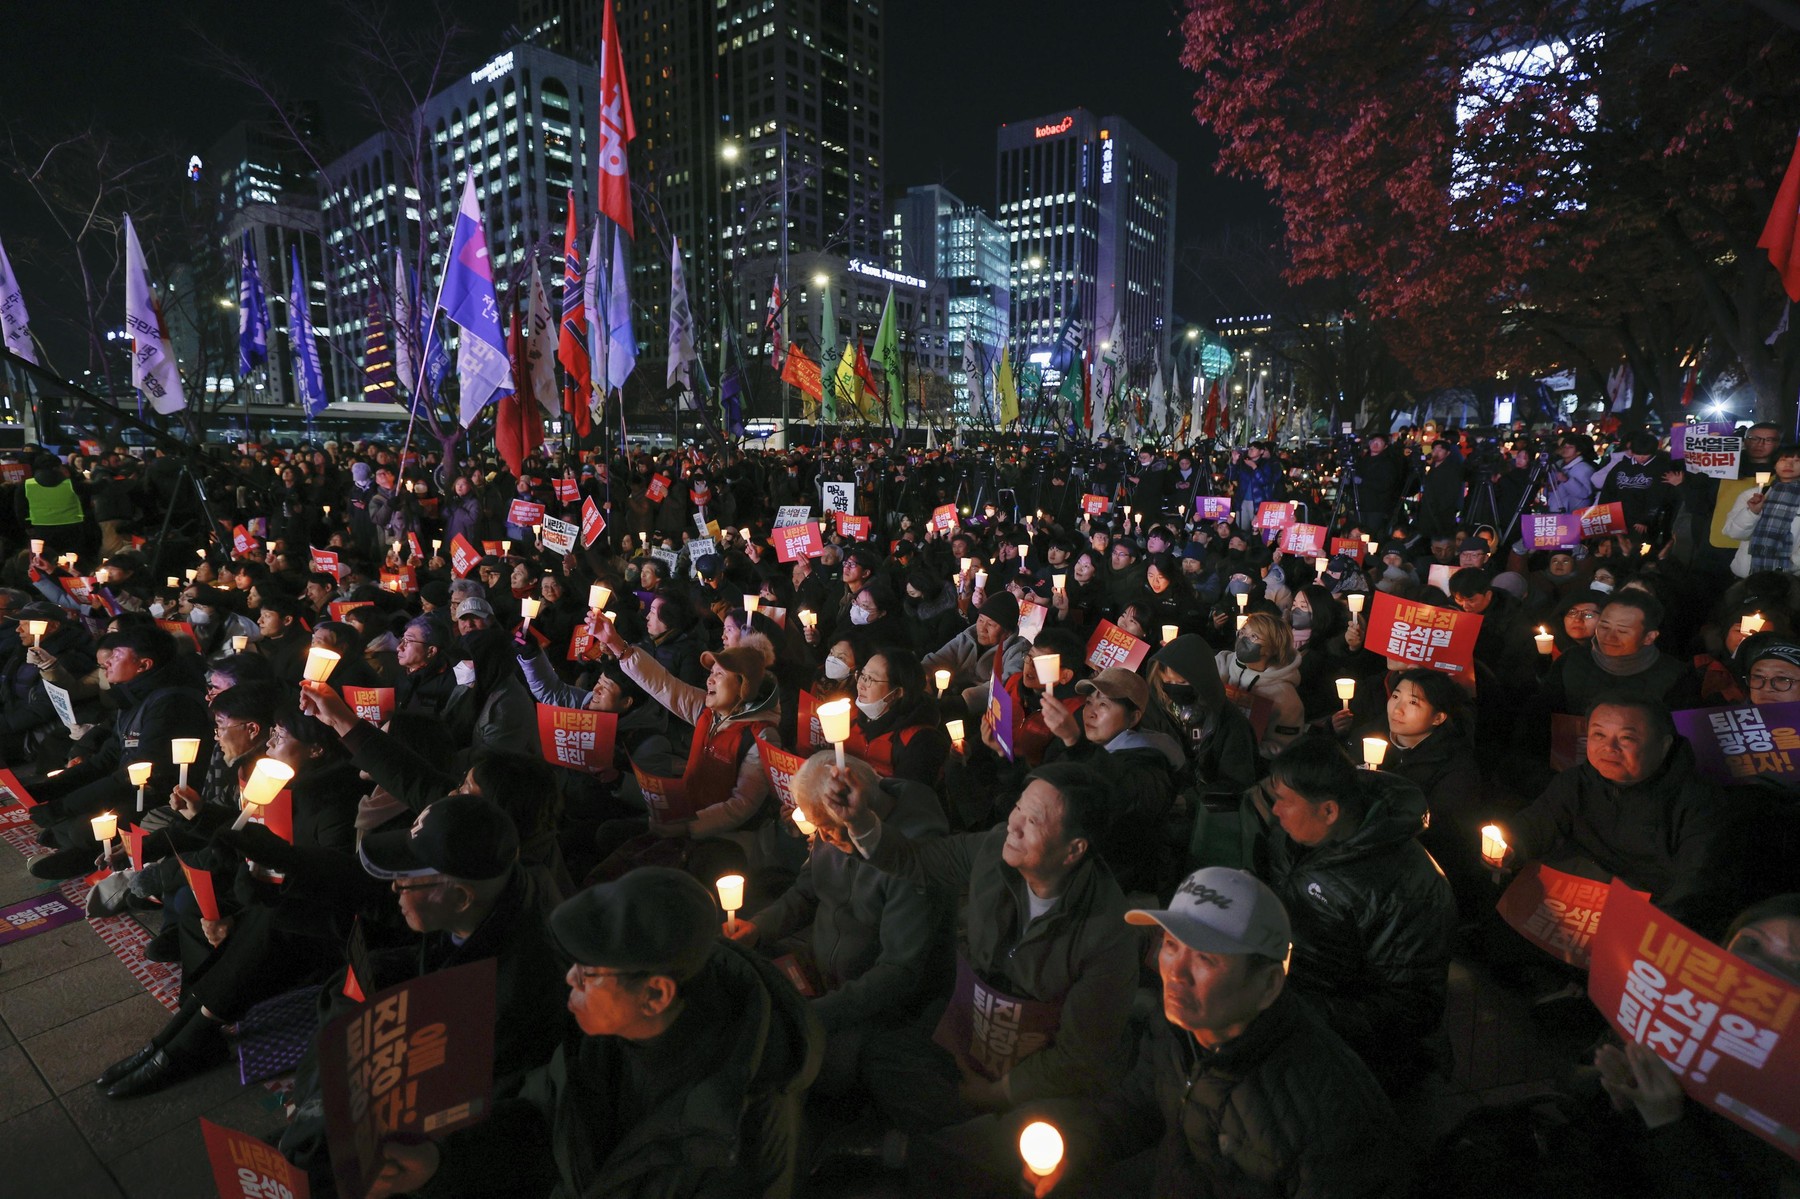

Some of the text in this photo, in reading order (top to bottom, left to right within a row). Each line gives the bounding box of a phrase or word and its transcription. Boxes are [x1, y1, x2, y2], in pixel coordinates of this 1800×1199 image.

[1035, 124, 1066, 138] kobaco
[1101, 139, 1113, 184] 서울신문
[1685, 437, 1740, 452] 윤석열을
[1684, 451, 1736, 467] 탄핵하라
[1263, 511, 1286, 519] 윤석열
[1534, 516, 1557, 527] 퇴진
[1581, 514, 1612, 527] 윤석열
[782, 525, 809, 539] 내란죄
[842, 523, 861, 531] 윤석열
[1534, 525, 1568, 537] 광장을
[785, 535, 811, 549] 윤석열
[1288, 533, 1316, 544] 윤석열
[1534, 536, 1560, 547] 열자!
[787, 546, 808, 558] 퇴진!
[1394, 603, 1458, 631] 내란죄
[1103, 627, 1137, 651] 내란죄
[1391, 621, 1453, 648] 윤석열
[1089, 650, 1116, 670] 퇴진!
[1096, 639, 1130, 664] 윤석열
[1386, 638, 1435, 662] 퇴진!
[354, 690, 379, 706] 내란죄
[356, 705, 381, 721] 윤석열
[553, 711, 598, 731] 내란죄
[1708, 708, 1767, 733] 퇴진
[554, 729, 596, 750] 윤석열
[1717, 727, 1800, 755] 광장을
[556, 746, 586, 766] 퇴진!
[766, 747, 798, 774] 내란죄
[1724, 752, 1794, 778] 열자!
[1637, 921, 1800, 1033] 내란죄
[973, 983, 1022, 1031] 퇴진
[1625, 959, 1780, 1070] 윤석열
[346, 989, 409, 1070] 퇴진
[1616, 992, 1721, 1084] 퇴진!
